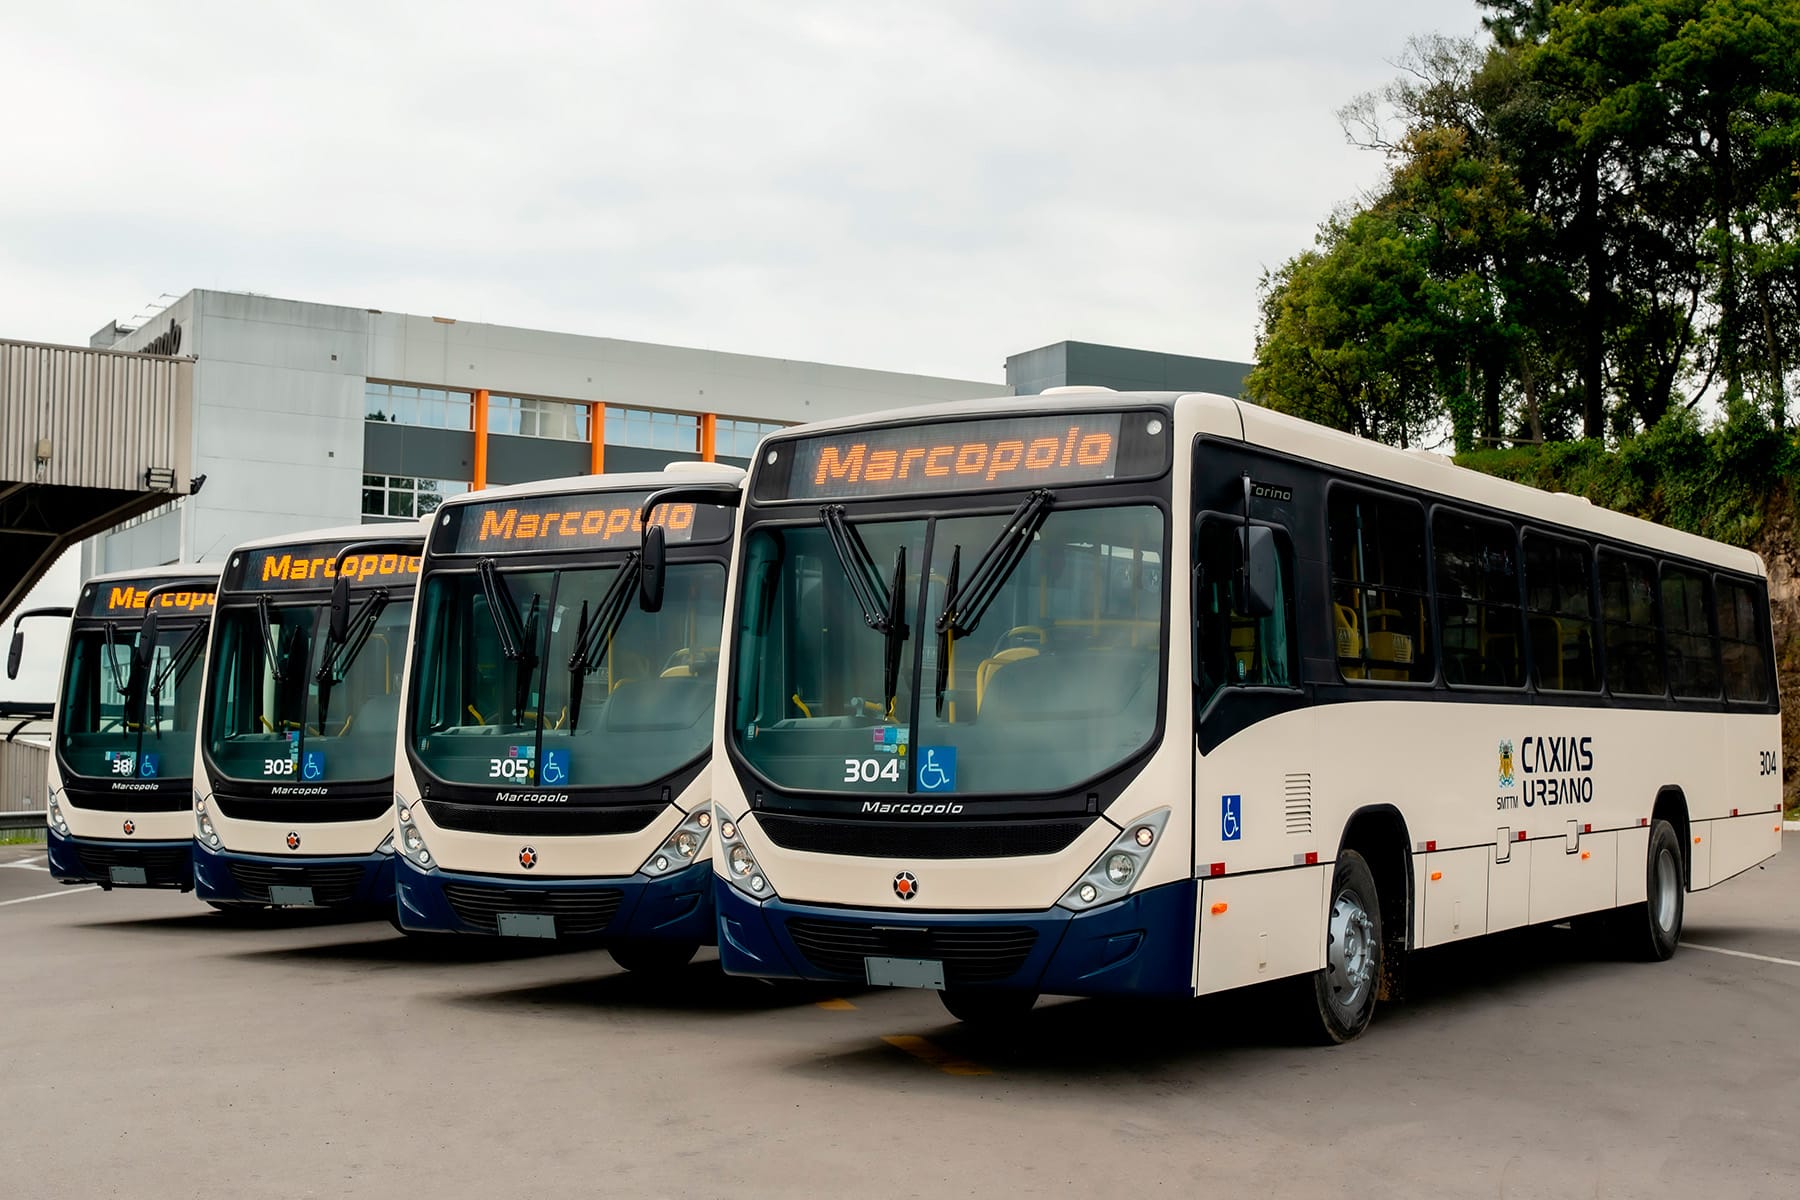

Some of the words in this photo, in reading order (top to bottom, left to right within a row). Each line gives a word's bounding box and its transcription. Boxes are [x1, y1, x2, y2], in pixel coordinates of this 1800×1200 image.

[815, 426, 1111, 484] Marcopolo
[479, 502, 694, 541] Marcopolo
[1521, 736, 1593, 774] CAXIAS
[1759, 750, 1777, 776] 304
[263, 758, 294, 776] 303
[489, 758, 529, 778] 305
[843, 758, 900, 783] 304
[111, 782, 160, 792] Marcopolo
[271, 786, 329, 796] Marcopolo
[495, 792, 569, 804] Marcopolo
[1522, 776, 1593, 808] URBANO
[861, 801, 964, 816] Marcopolo
